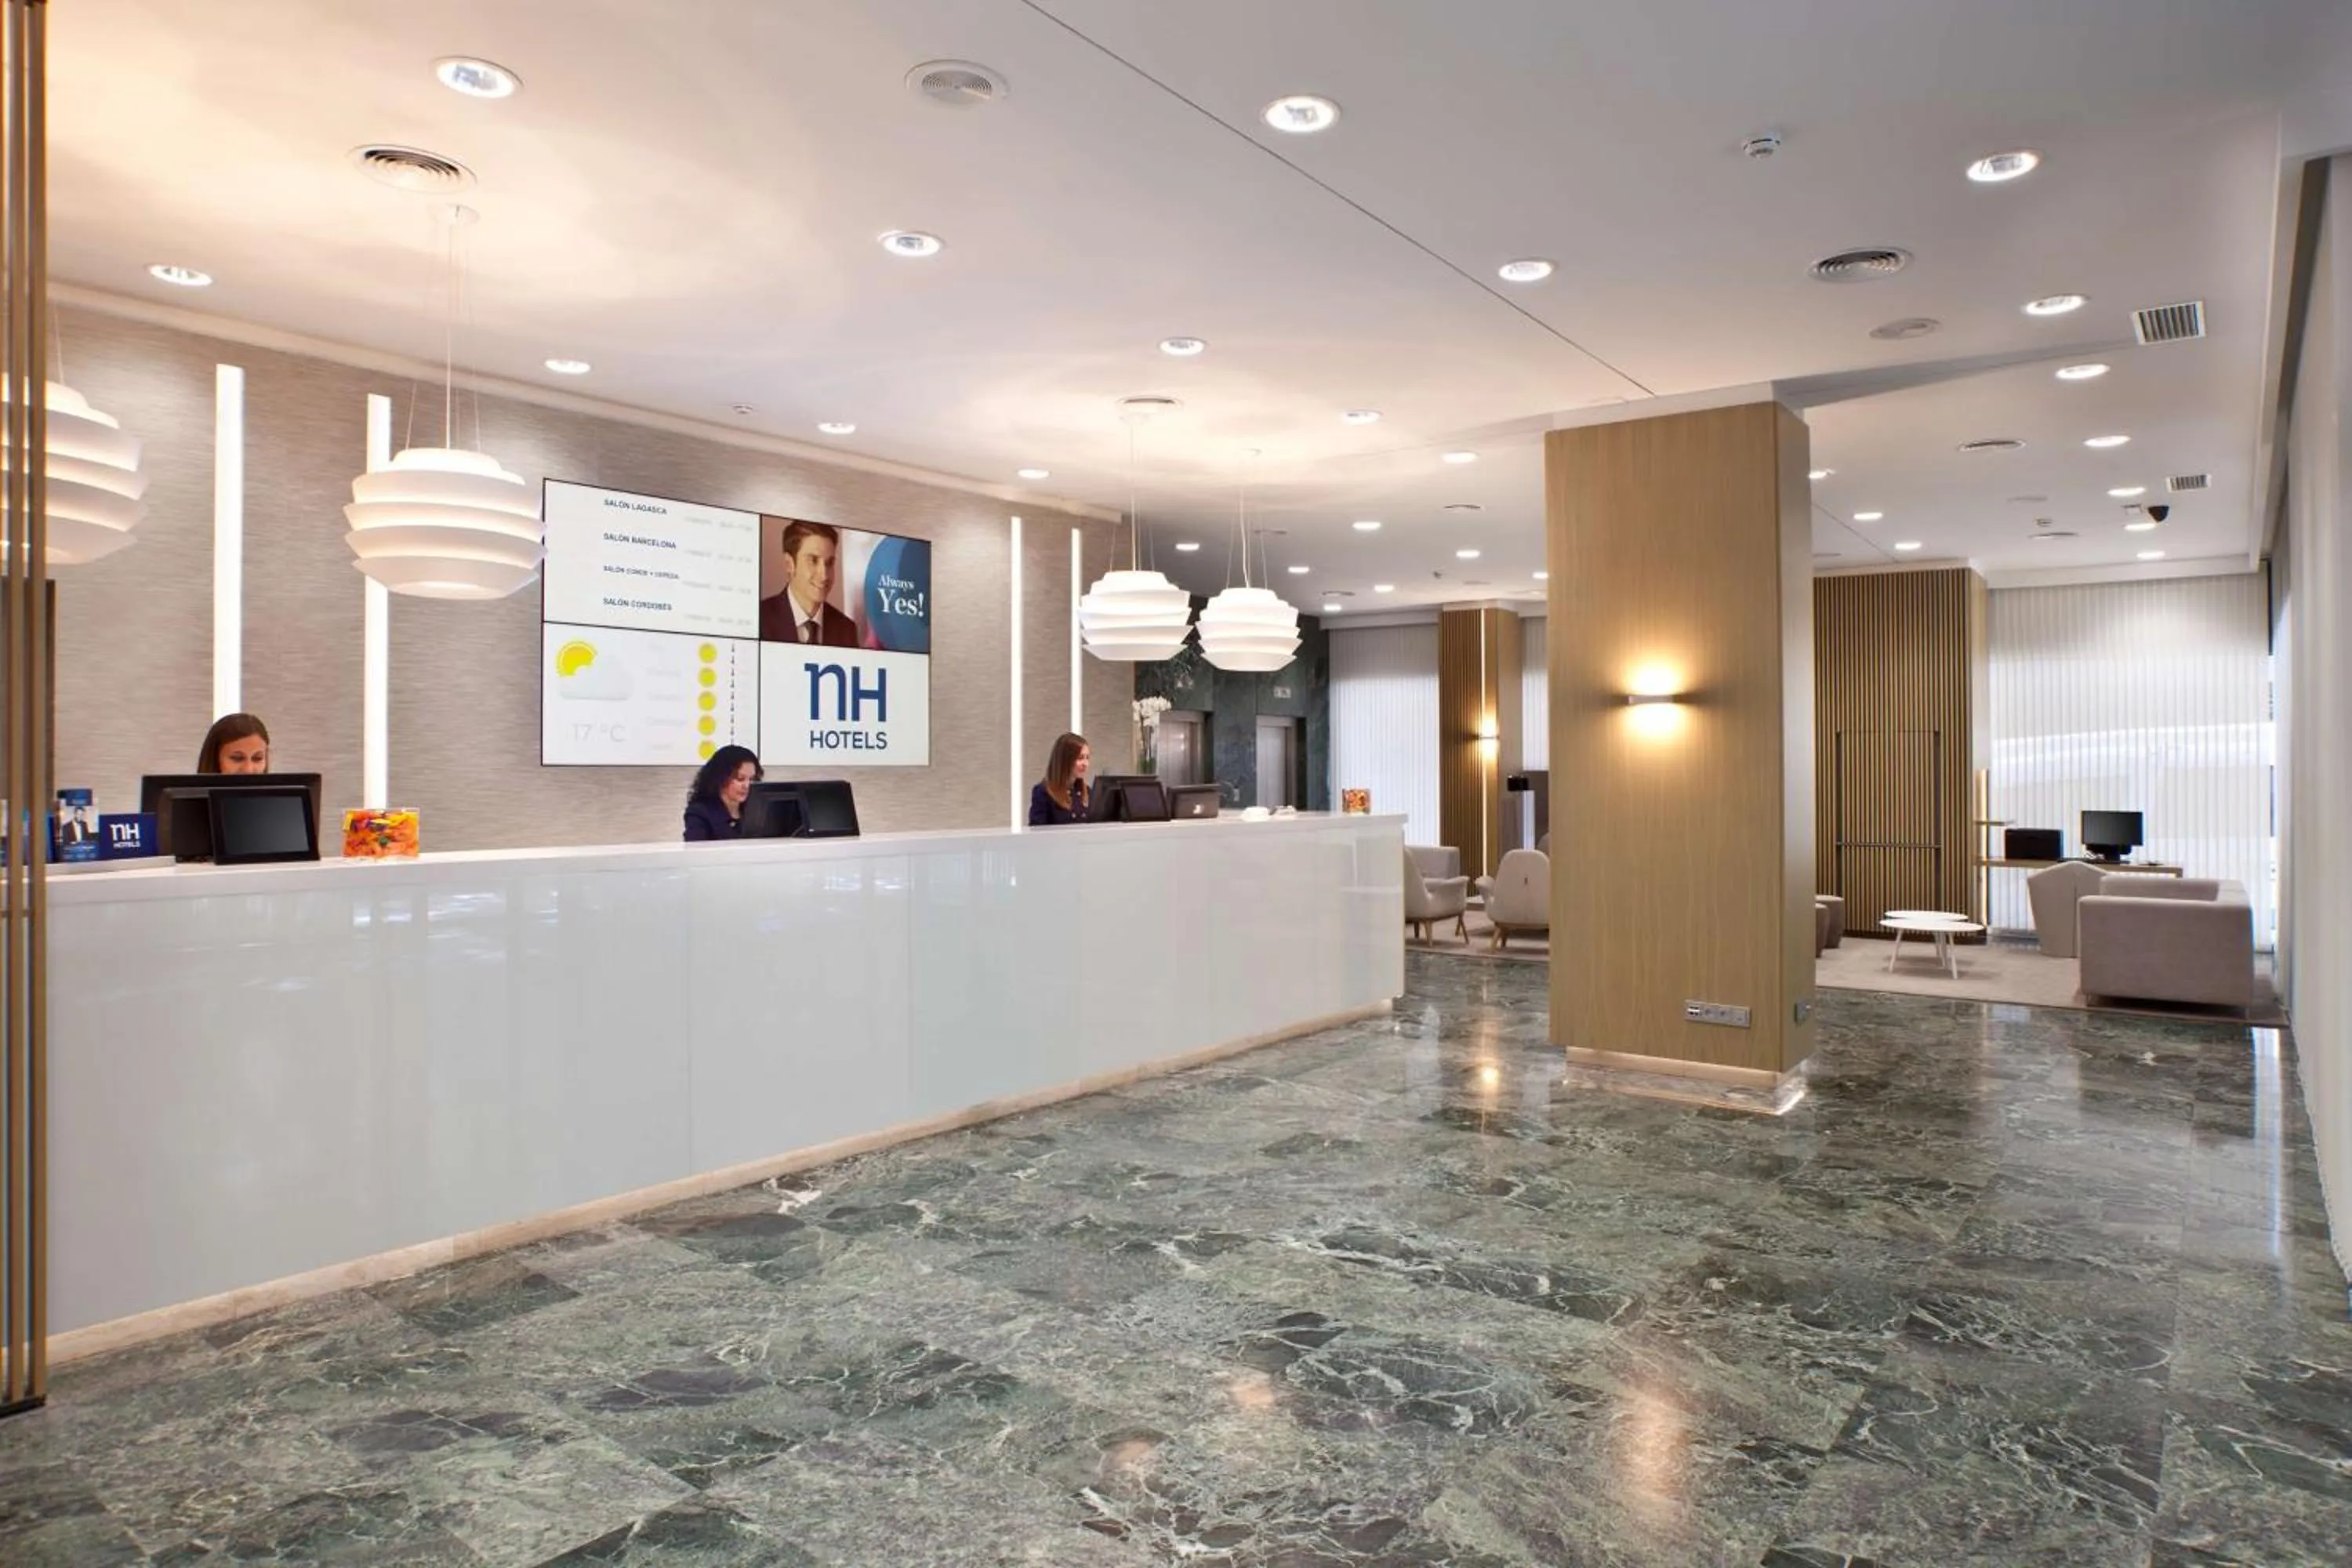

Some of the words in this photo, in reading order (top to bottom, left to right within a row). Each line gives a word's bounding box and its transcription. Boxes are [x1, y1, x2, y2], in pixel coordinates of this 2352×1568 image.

[631, 503, 667, 514] LAGASCA
[631, 536, 677, 550] BARCELONA
[878, 574, 915, 592] Always
[878, 588, 924, 617] Yes!
[809, 730, 888, 750] HOTELS
[113, 840, 141, 849] HOTELS
